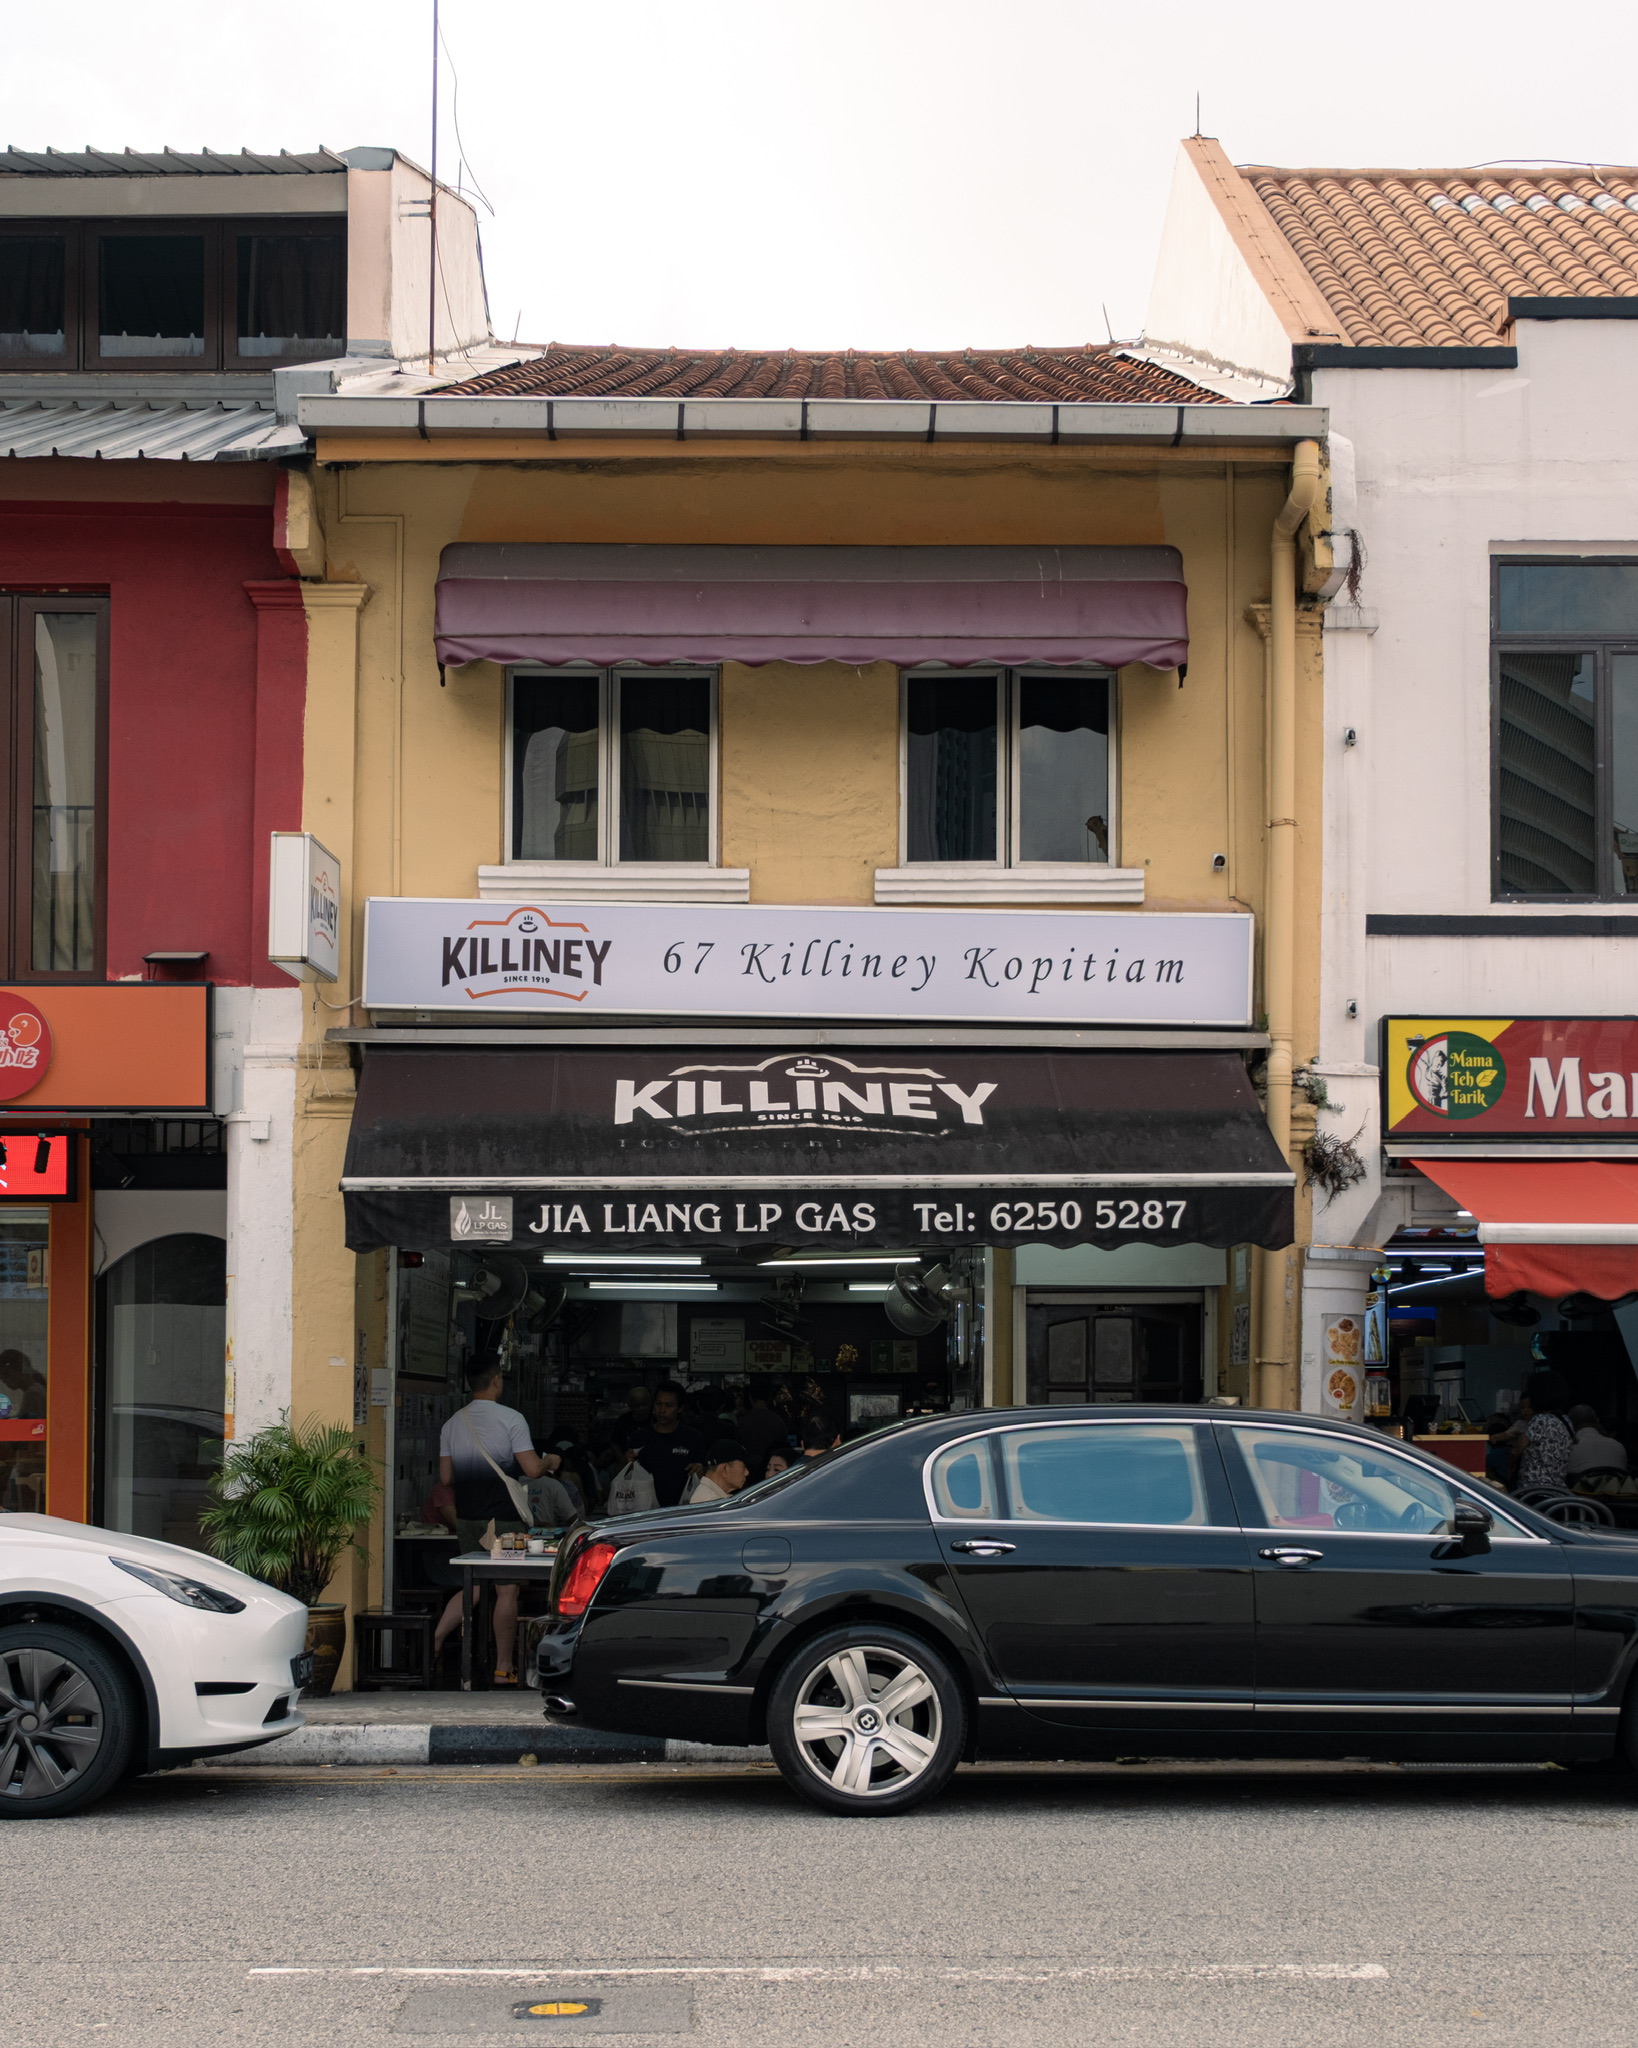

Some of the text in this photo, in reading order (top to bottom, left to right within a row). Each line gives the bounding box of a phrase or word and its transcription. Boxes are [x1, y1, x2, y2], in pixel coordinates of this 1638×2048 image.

[441, 936, 613, 987] KILLINEY
[663, 939, 1185, 994] 67 Killiney Kopitiam
[503, 975, 551, 984] SINCE 1919
[1449, 1049, 1493, 1068] Mama
[1450, 1070, 1475, 1088] Teh
[614, 1079, 999, 1125] KILLINEY
[1450, 1089, 1489, 1108] Tarik
[757, 1112, 863, 1122] SINCE 1919
[478, 1201, 502, 1220] JL
[529, 1200, 1187, 1233] JIA LIANG LP GAS Tel: 6250 5287
[473, 1221, 507, 1230] LP GAS
